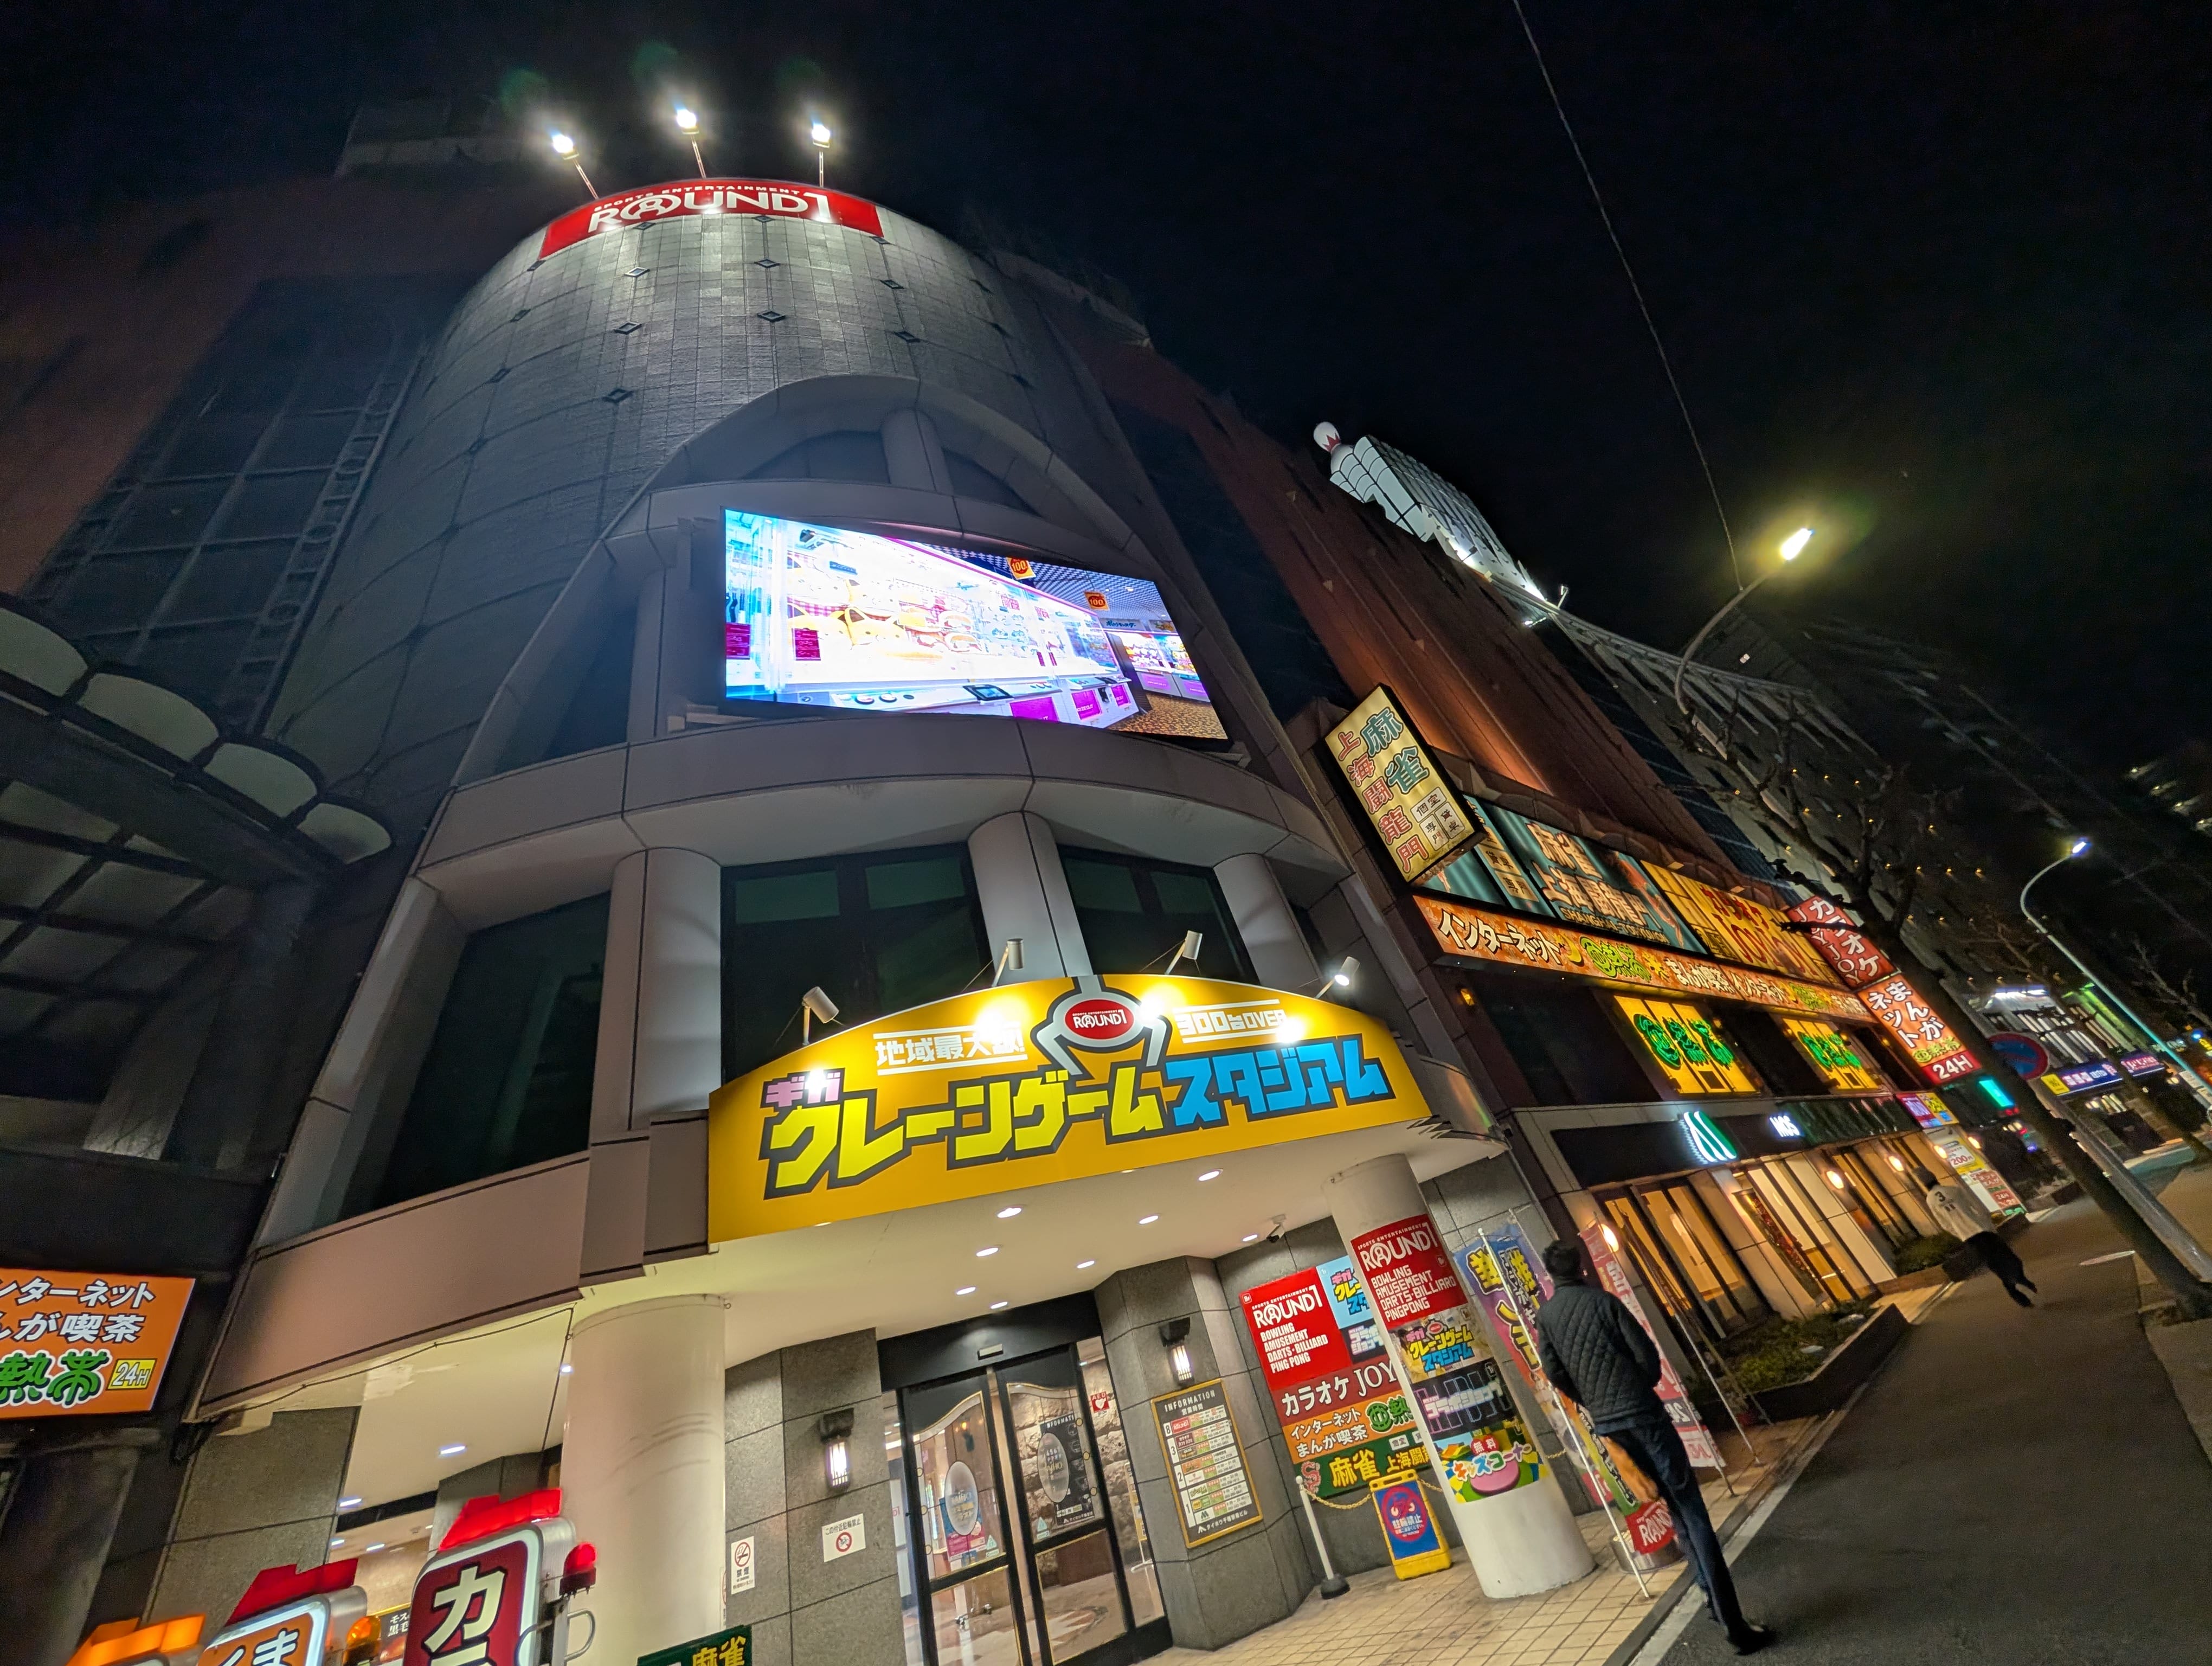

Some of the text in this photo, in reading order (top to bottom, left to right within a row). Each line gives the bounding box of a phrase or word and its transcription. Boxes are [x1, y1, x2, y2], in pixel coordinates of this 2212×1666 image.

[594, 185, 800, 210] SPORTS ENTERTAINMENT
[1361, 708, 1429, 794] 麻雀
[1338, 731, 1429, 872] 上海闘龍門
[1416, 793, 1440, 816] 個室
[1526, 823, 1603, 879] 麻雀
[1532, 861, 1663, 931] 上海闘龍門
[1438, 909, 1562, 965] インターネット
[1666, 958, 1734, 993] まんが喫茶
[1732, 971, 1789, 1003] インターネット
[1795, 908, 1863, 984] JYJOY
[1073, 1009, 1127, 1028] ROUND1
[1868, 992, 1919, 1048] ネット
[1885, 982, 1945, 1041] まんが
[1932, 1055, 1973, 1080] 24H
[766, 1072, 840, 1107] ギガ
[1332, 1269, 1352, 1285] ギガ
[1371, 1265, 1412, 1289] BOWLING
[1375, 1270, 1433, 1299] AMUSEMENT
[1253, 1284, 1323, 1329] ROUND1
[1385, 1297, 1430, 1322] PINGPONG
[1260, 1322, 1295, 1342] BOWLING
[1264, 1329, 1309, 1353] AMUSEMENT
[1406, 1328, 1425, 1342] ギガ
[1410, 1325, 1474, 1359] クレーンゲーム
[1270, 1352, 1311, 1374] PING PONG
[1423, 1343, 1475, 1373] スタジアム
[113, 1363, 150, 1386] 24H
[1165, 1390, 1215, 1412] INFORMATION
[1282, 1373, 1349, 1418] カラオケ
[1166, 1425, 1171, 1434] 8
[1291, 1406, 1361, 1440] インターネット
[1171, 1446, 1176, 1455] 3
[1295, 1424, 1368, 1457] まんが喫茶
[1328, 1449, 1381, 1488] 麻雀
[1454, 1442, 1531, 1481] キッズコーナー
[1178, 1472, 1182, 1482] 2
[1186, 1504, 1190, 1514] 1
[390, 1612, 409, 1623] モス
